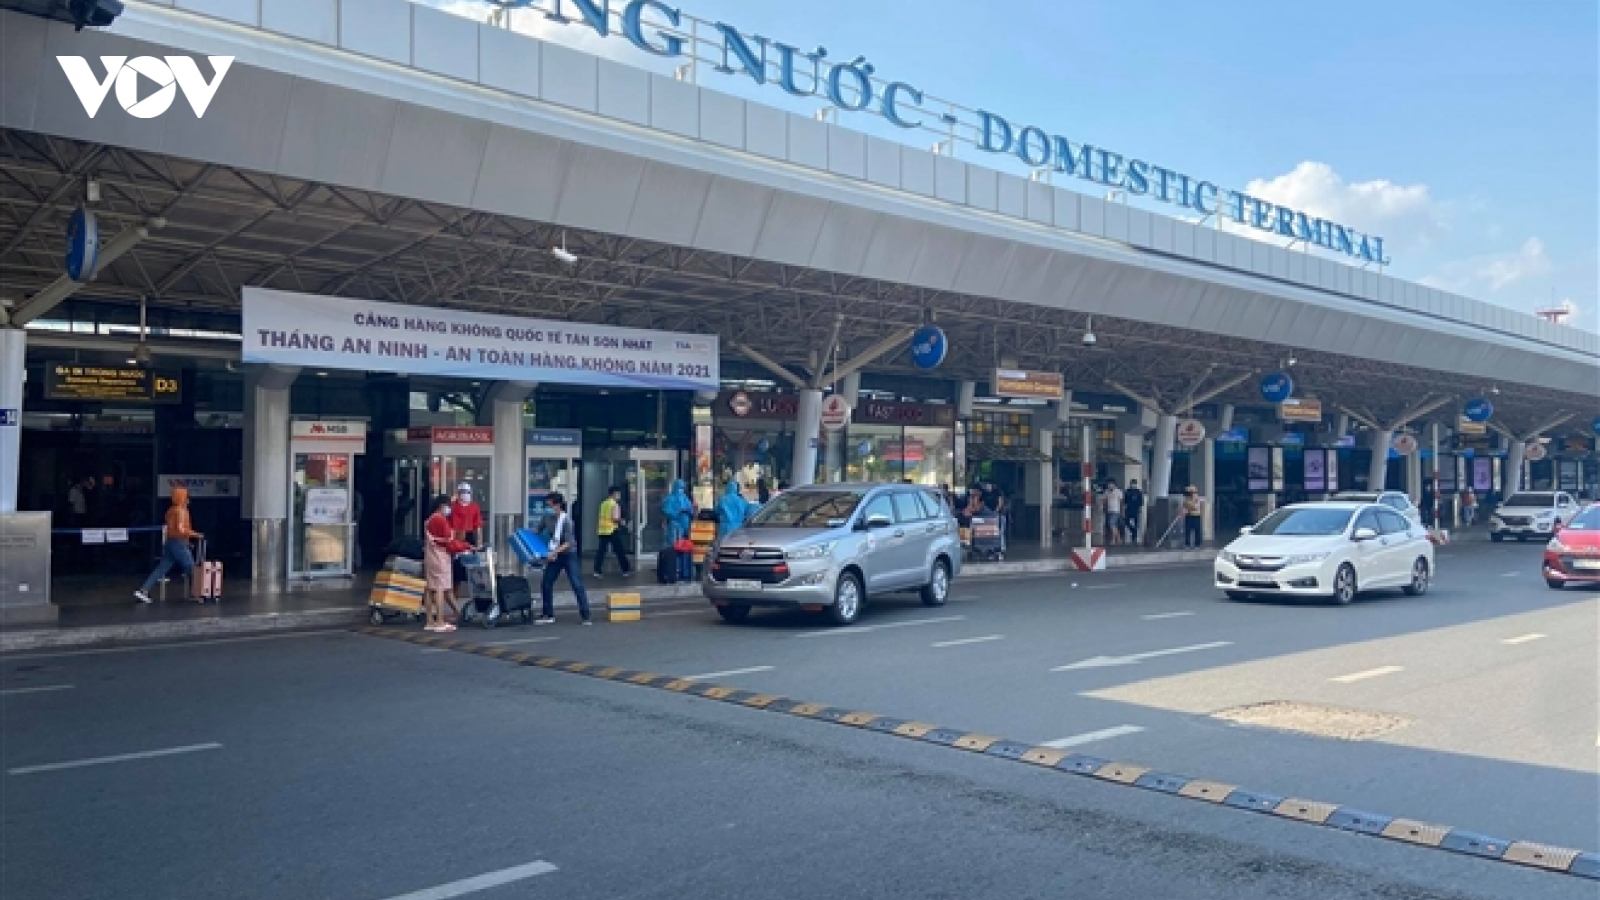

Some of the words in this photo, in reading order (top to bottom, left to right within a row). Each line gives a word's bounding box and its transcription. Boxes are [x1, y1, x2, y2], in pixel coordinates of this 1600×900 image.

[485, 0, 684, 57] NG
[714, 20, 923, 129] NƯỚC
[976, 108, 1221, 216] DOMESTIC
[1228, 190, 1391, 266] TERMINAL
[257, 328, 333, 352] THÁNG
[341, 337, 371, 355] AN
[378, 340, 428, 359] NINH
[445, 346, 471, 361] AN
[476, 346, 524, 366] TOÀN
[531, 351, 578, 370] HÀNG
[581, 355, 636, 374] KHÔNG
[640, 359, 673, 376] NĂM
[676, 362, 711, 378] 2021
